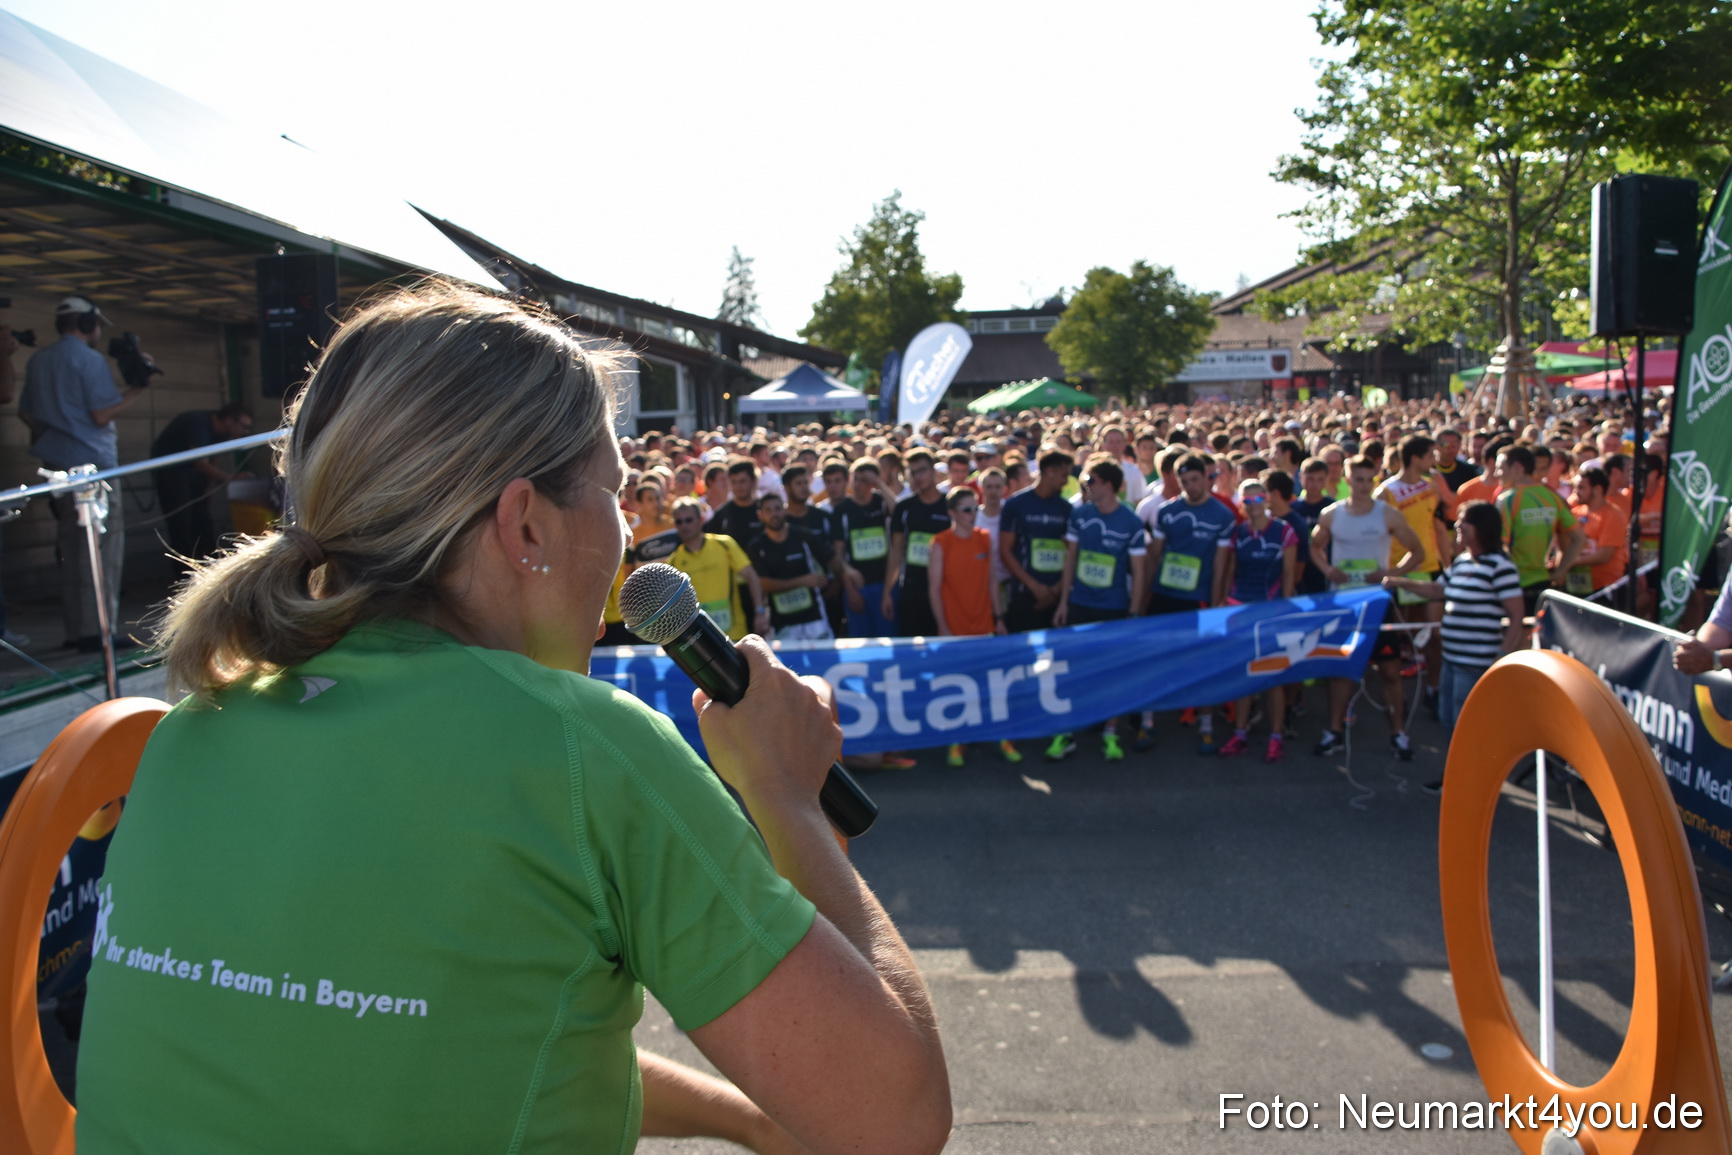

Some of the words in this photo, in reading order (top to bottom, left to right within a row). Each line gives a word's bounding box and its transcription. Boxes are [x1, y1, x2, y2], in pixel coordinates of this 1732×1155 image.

[1670, 450, 1729, 526] AOK
[1660, 552, 1701, 611] AOK
[823, 648, 1072, 740] Start
[1664, 756, 1692, 788] und
[105, 935, 126, 964] Ihr
[127, 947, 204, 981] starkes
[210, 959, 273, 997] Team
[281, 972, 307, 1002] in
[315, 979, 429, 1019] Bayern
